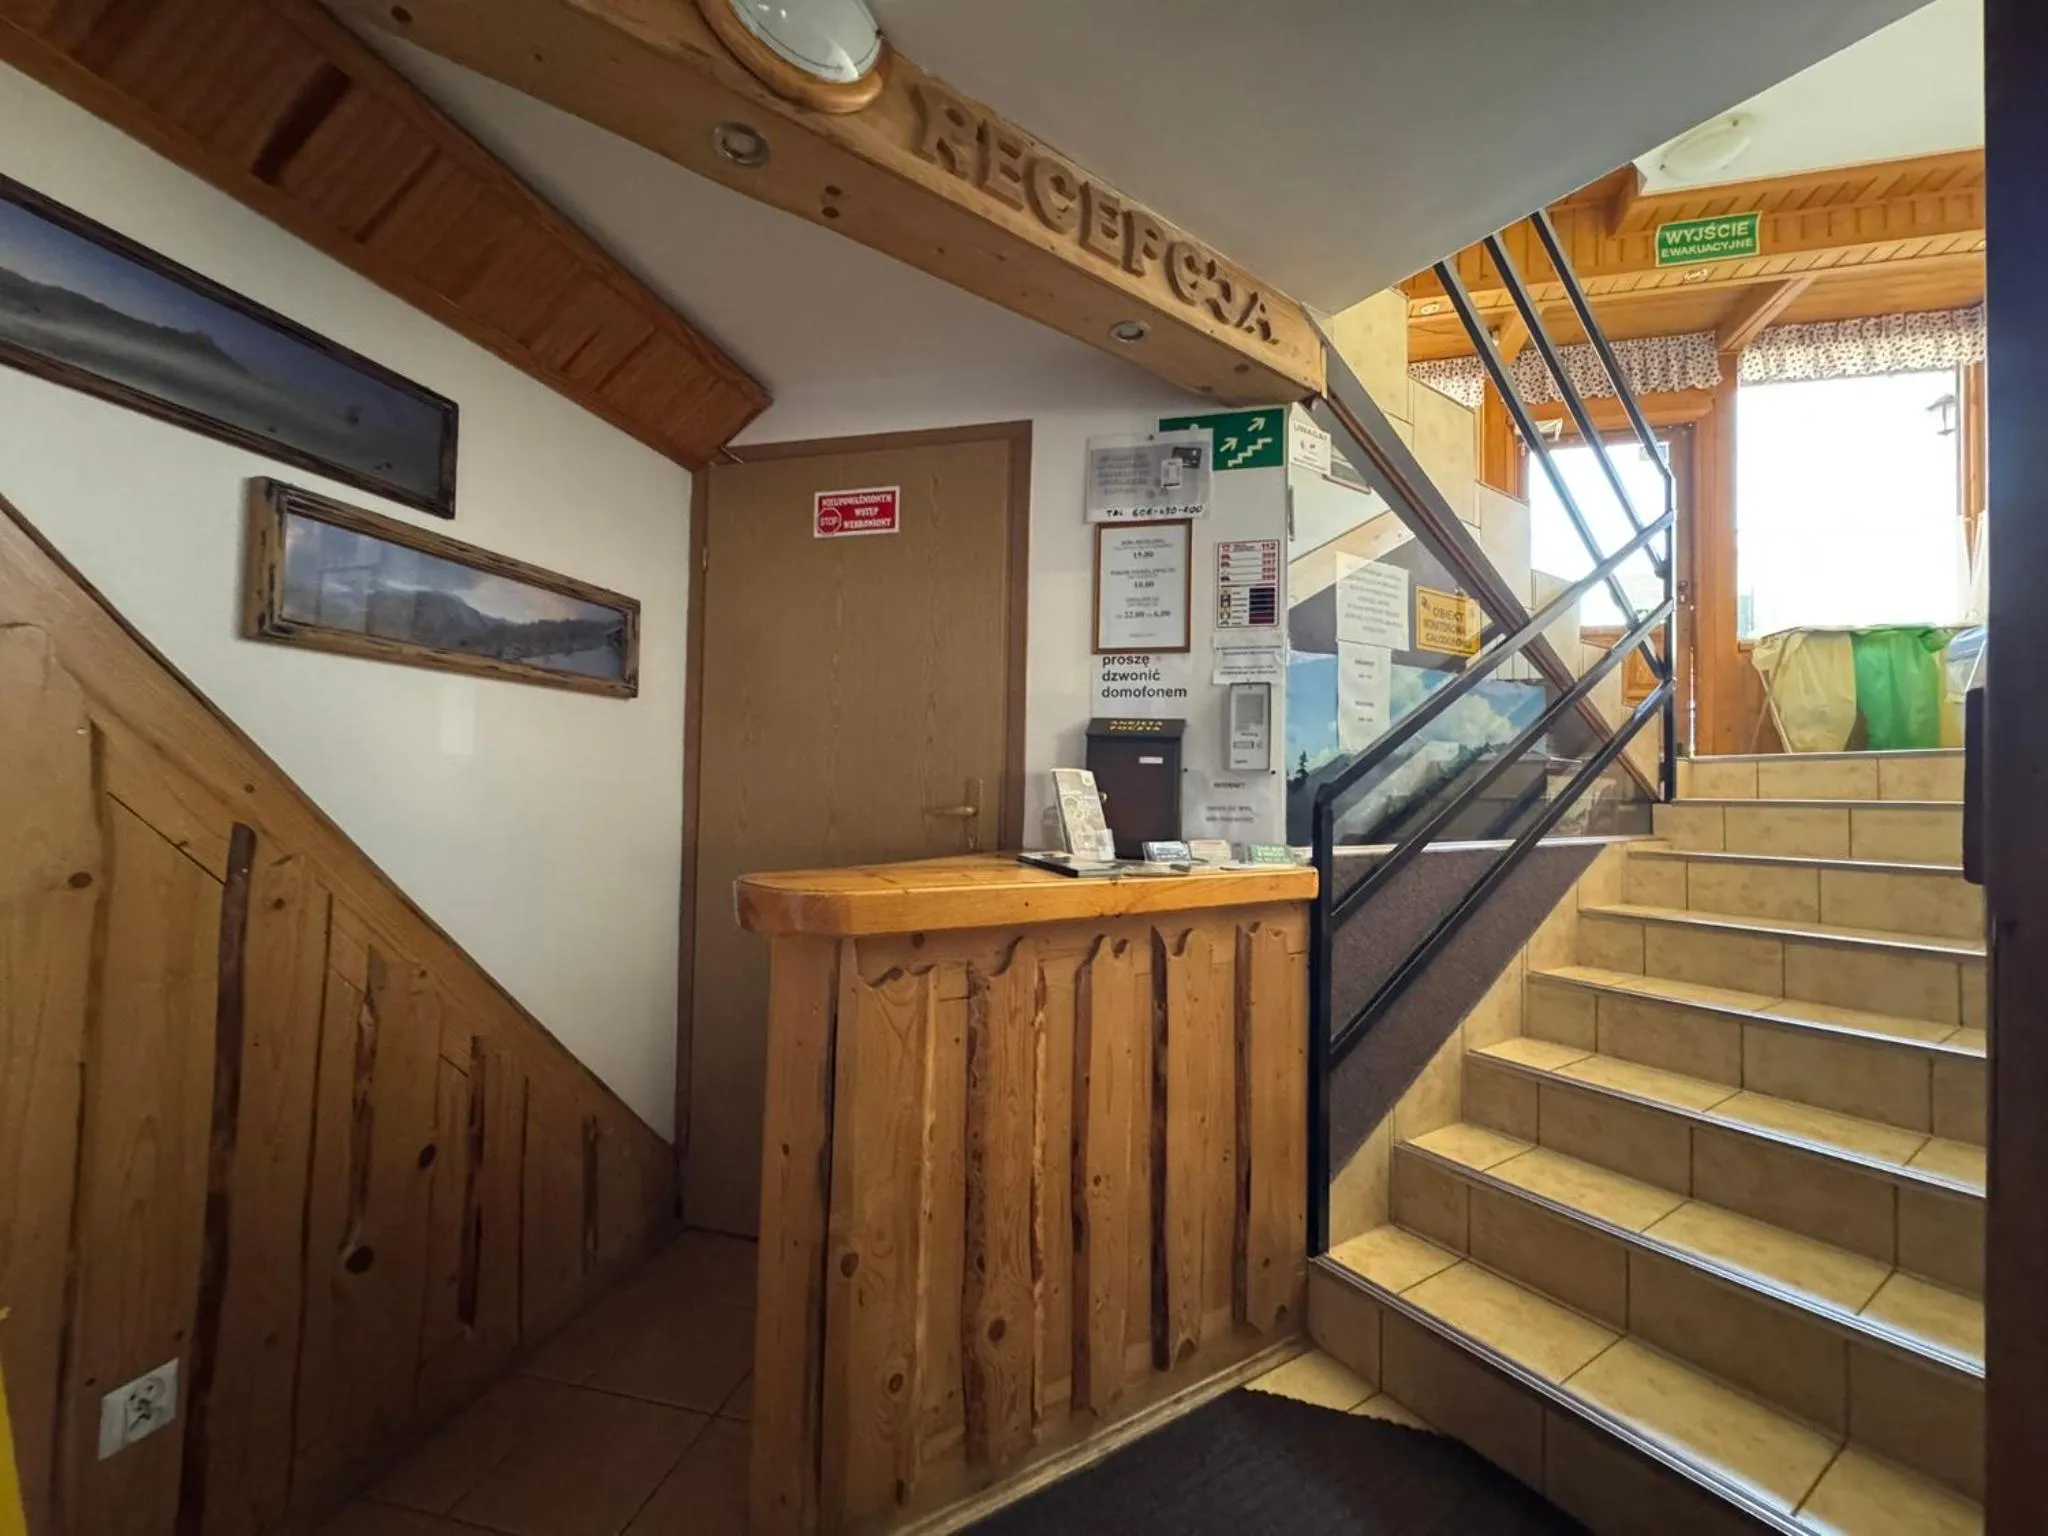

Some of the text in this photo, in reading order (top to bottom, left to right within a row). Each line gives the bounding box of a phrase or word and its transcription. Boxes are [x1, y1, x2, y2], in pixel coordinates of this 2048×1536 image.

[911, 84, 1280, 345] RECEPCJA
[1665, 221, 1749, 245] WYJŚCIE
[1660, 238, 1754, 258] EWAKUACYJNE
[820, 515, 838, 527] STOP
[1102, 655, 1150, 668] proszę
[1101, 669, 1161, 682] dzwonić
[1101, 685, 1188, 698] domofonem
